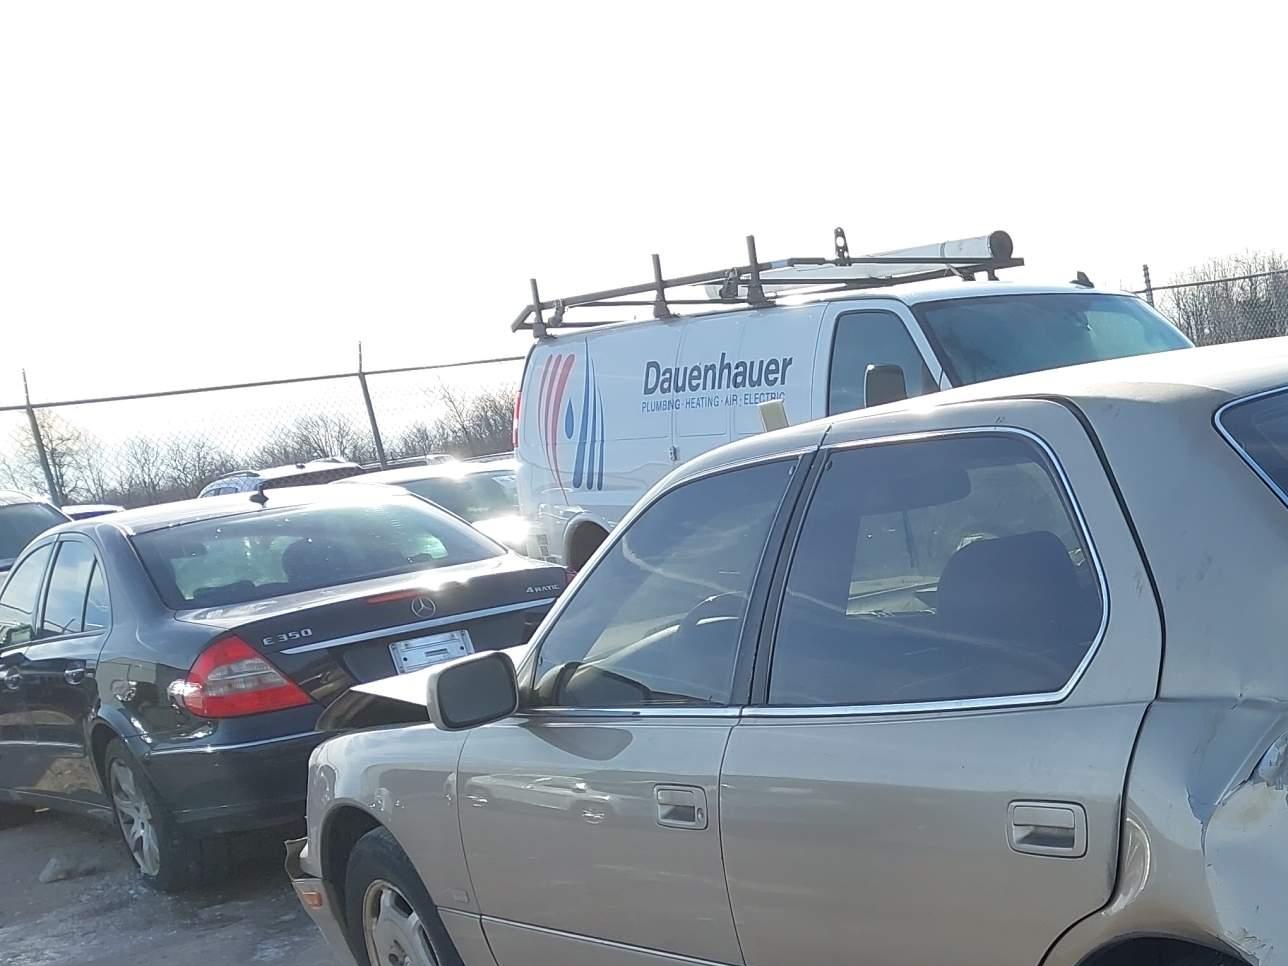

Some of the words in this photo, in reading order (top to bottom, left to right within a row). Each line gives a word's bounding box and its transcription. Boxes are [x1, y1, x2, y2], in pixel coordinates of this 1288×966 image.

[643, 352, 793, 395] Dauenhauer
[641, 399, 681, 413] PLUMBING
[686, 395, 720, 408] HEATING
[725, 394, 738, 406] AIR
[263, 637, 274, 646] E
[277, 628, 313, 643] 350
